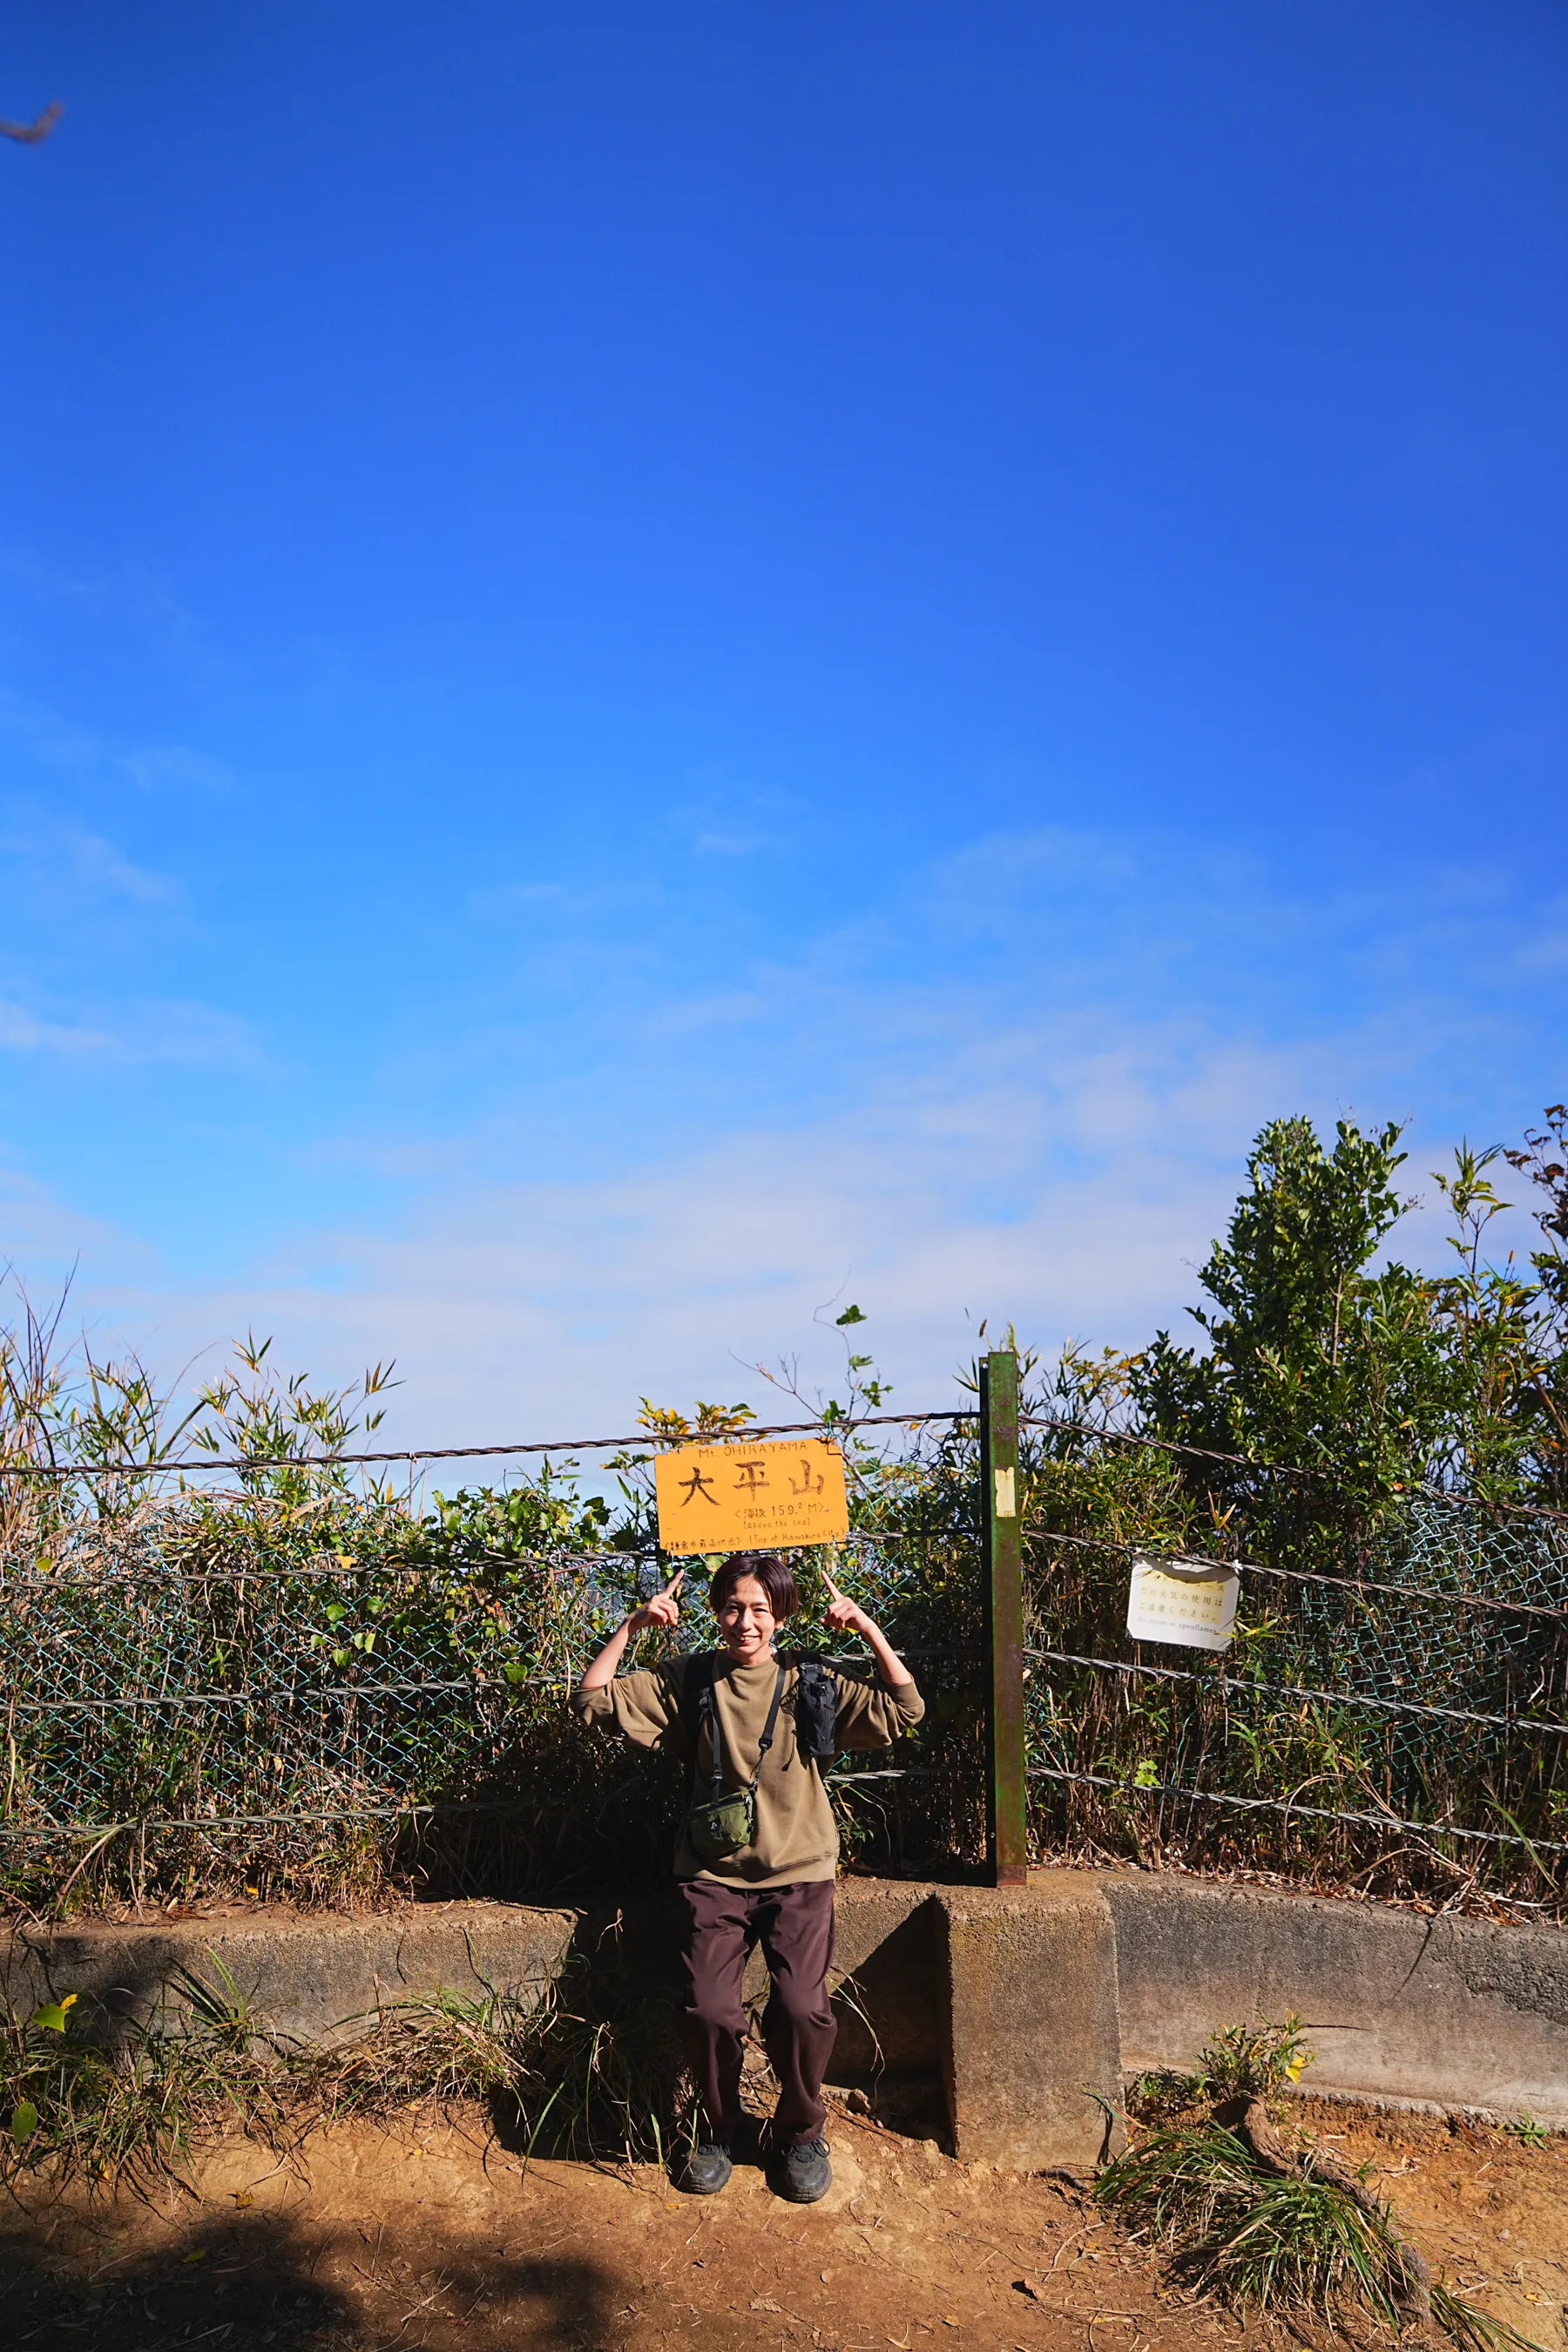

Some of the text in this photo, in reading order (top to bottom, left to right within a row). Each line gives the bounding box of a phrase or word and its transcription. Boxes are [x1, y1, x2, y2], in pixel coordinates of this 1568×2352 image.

[699, 1441, 808, 1459] Mt. OHIRAYAMA
[678, 1459, 826, 1508] 大平山
[743, 1520, 772, 1530] (above
[793, 1517, 811, 1526] sea)
[749, 1534, 767, 1544] (Top
[781, 1532, 821, 1541] Kamakura
[1140, 1587, 1223, 1606] での火気の使用は
